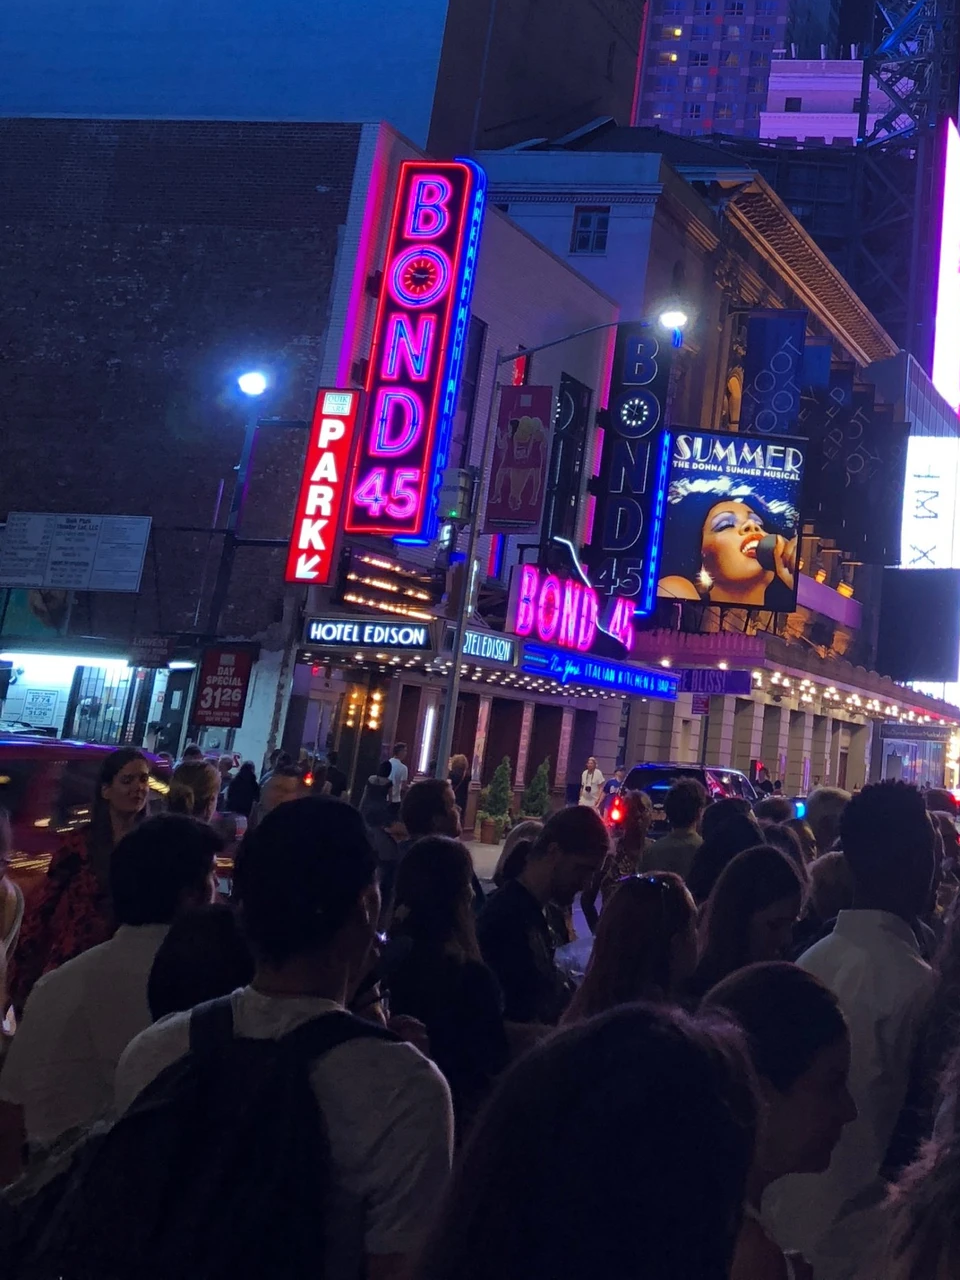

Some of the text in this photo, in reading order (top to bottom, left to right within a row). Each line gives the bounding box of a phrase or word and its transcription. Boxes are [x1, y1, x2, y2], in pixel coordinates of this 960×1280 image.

[369, 173, 454, 459] BOND
[602, 336, 661, 551] BOND
[673, 434, 804, 473] SUMMER
[298, 418, 346, 551] PARK
[672, 460, 800, 481] THE DONNA SUMMER MUSICAL
[353, 466, 420, 517] 45
[594, 558, 643, 597] 45
[515, 563, 598, 652] BOND
[310, 622, 426, 646] HOTEL EDISON
[481, 636, 511, 662] EDISON
[206, 675, 242, 686] SPECIAL
[217, 666, 235, 676] DAY
[584, 663, 616, 683] ITALIAN
[617, 670, 649, 691] KITCHEN
[657, 678, 669, 693] BAR
